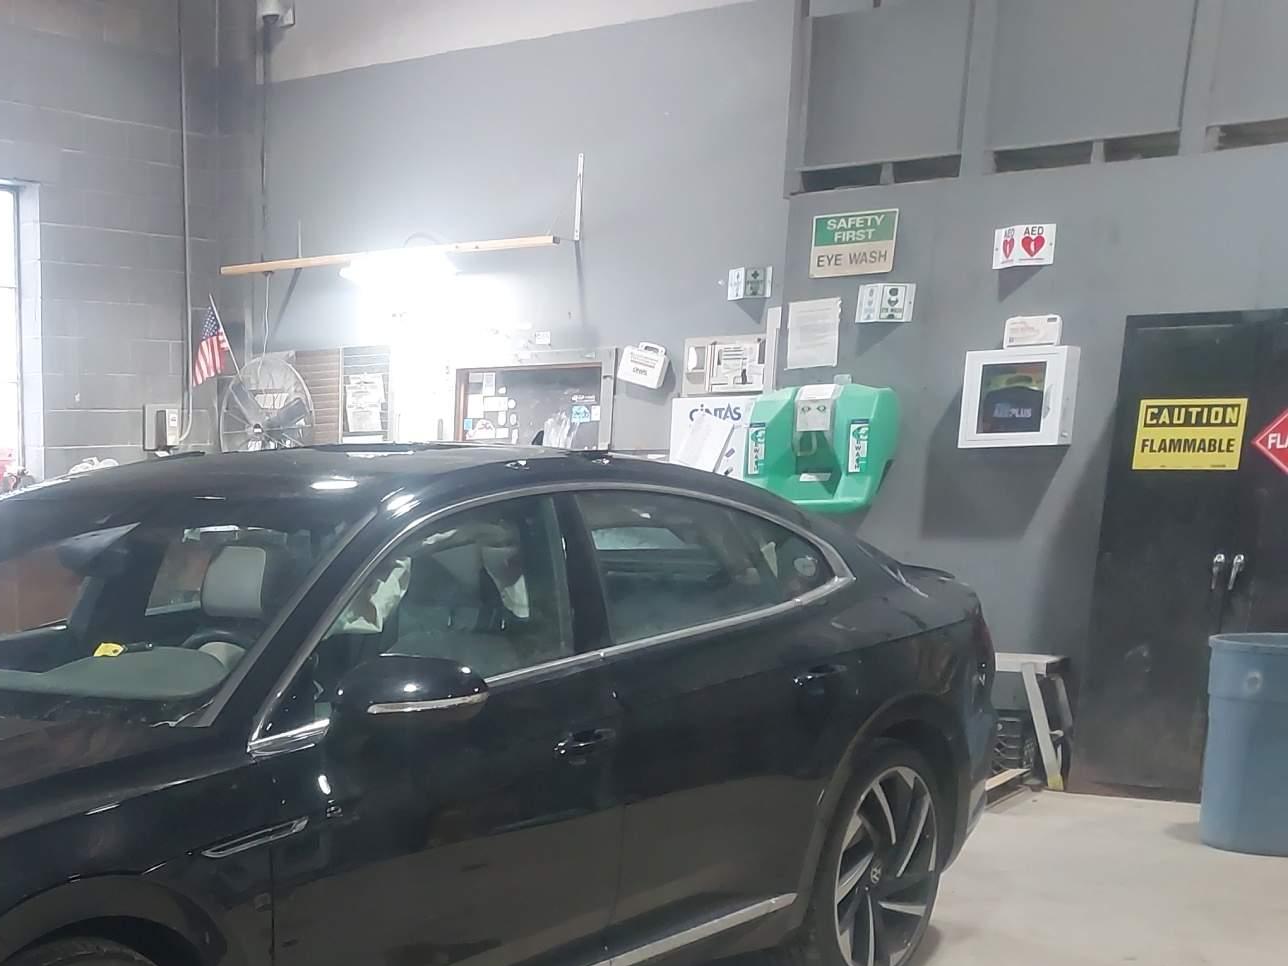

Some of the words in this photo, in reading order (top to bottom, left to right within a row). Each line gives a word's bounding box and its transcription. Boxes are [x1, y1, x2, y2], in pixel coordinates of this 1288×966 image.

[826, 214, 885, 231] SAFETY
[833, 228, 876, 243] FIRST
[1024, 226, 1044, 236] AED
[816, 253, 843, 268] EYE
[848, 249, 888, 265] WASH
[1145, 406, 1239, 425] CAUTION
[1140, 438, 1236, 453] FLAMMABLE
